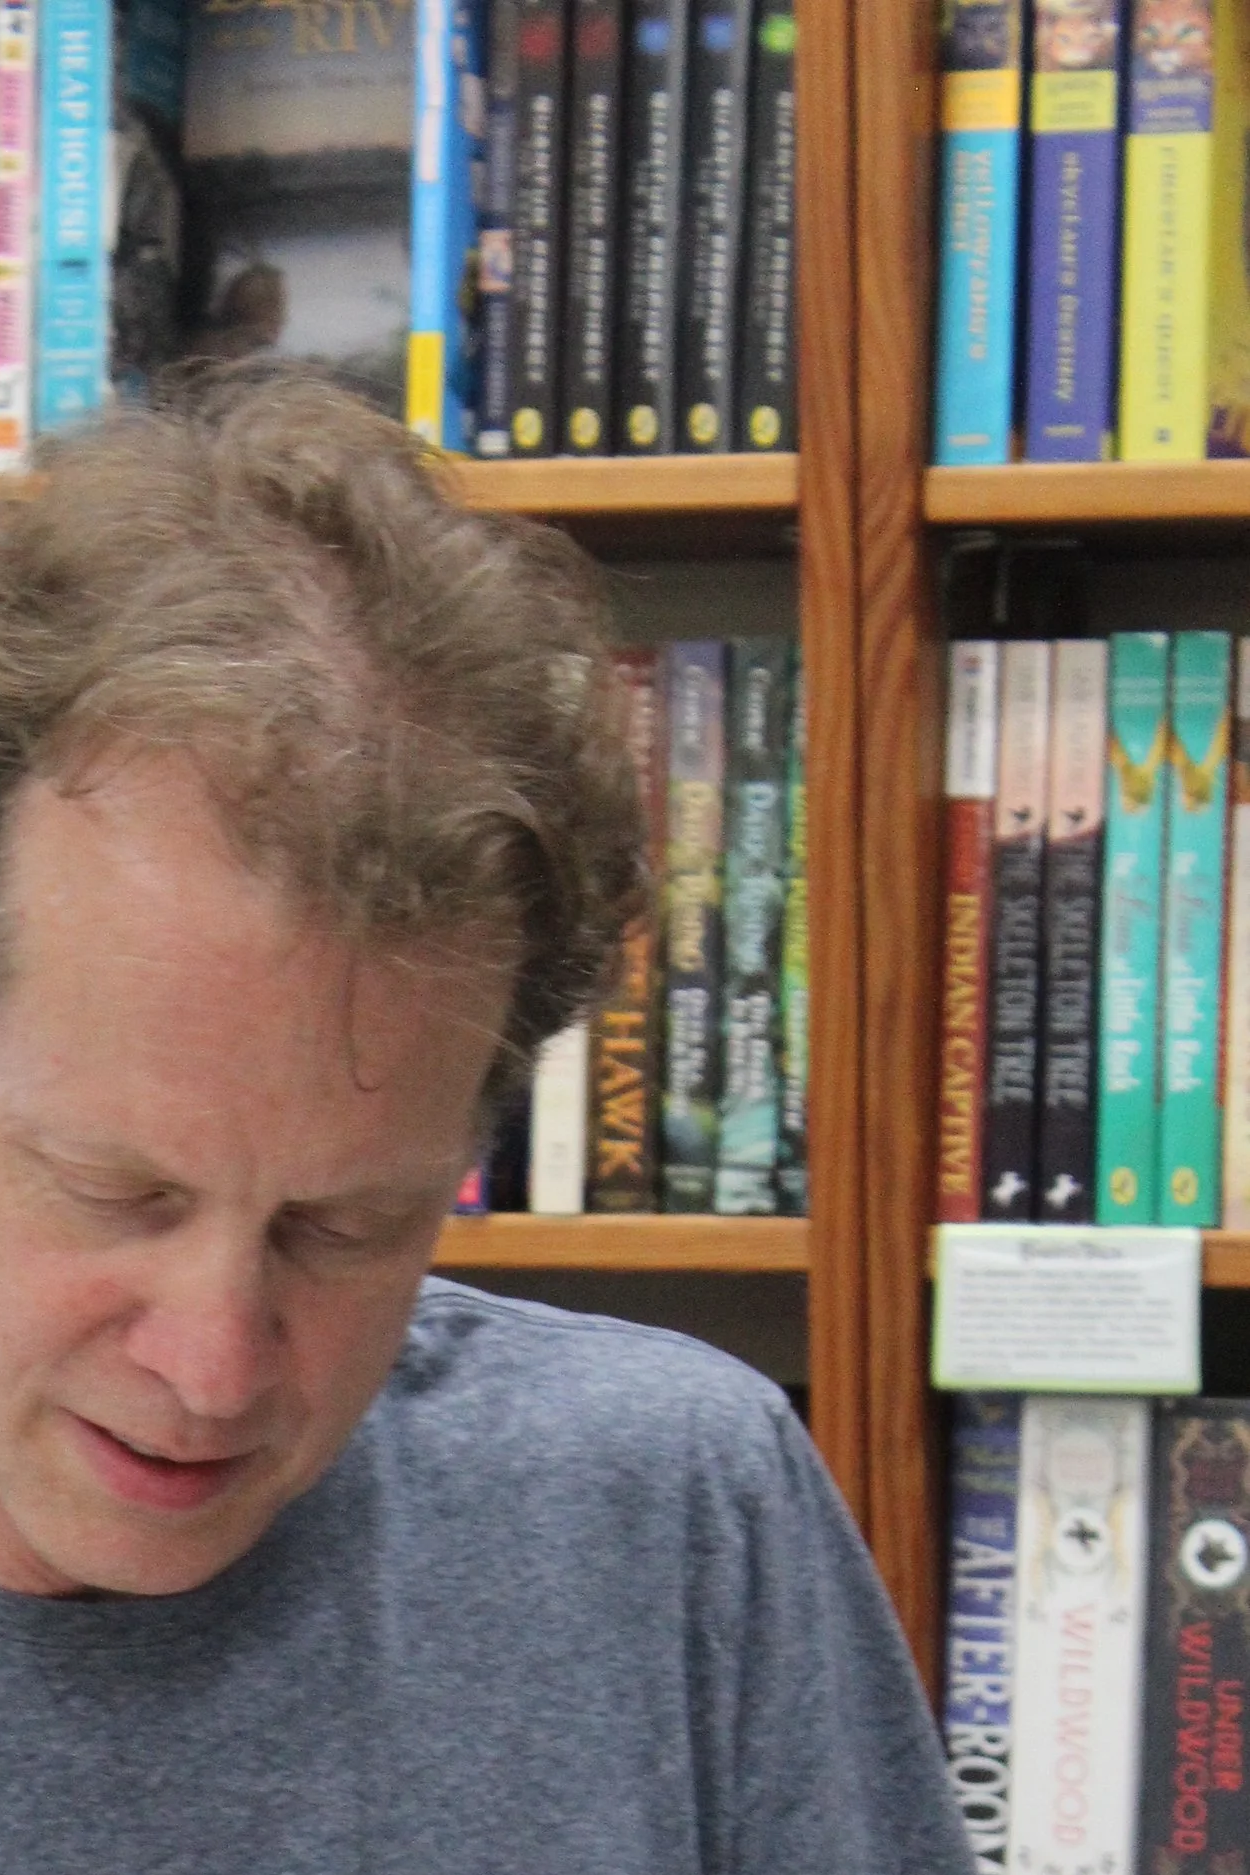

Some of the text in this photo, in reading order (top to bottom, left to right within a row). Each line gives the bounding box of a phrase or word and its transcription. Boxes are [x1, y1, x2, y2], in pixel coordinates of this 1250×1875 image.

[58, 30, 91, 119] HEAP
[56, 127, 91, 246] HOUSE
[996, 892, 1038, 1030] SKELETON
[1046, 893, 1091, 1030] SKELETON
[598, 1011, 647, 1178] HAWK
[939, 893, 981, 1197] INDIAN CAPTIVE
[993, 1041, 1035, 1107] TREE
[1045, 1042, 1088, 1108] TREE
[1054, 1605, 1096, 1850] WILDWOOD
[1171, 1621, 1211, 1854] WILDWOOD
[1211, 1679, 1244, 1791] UNDER
